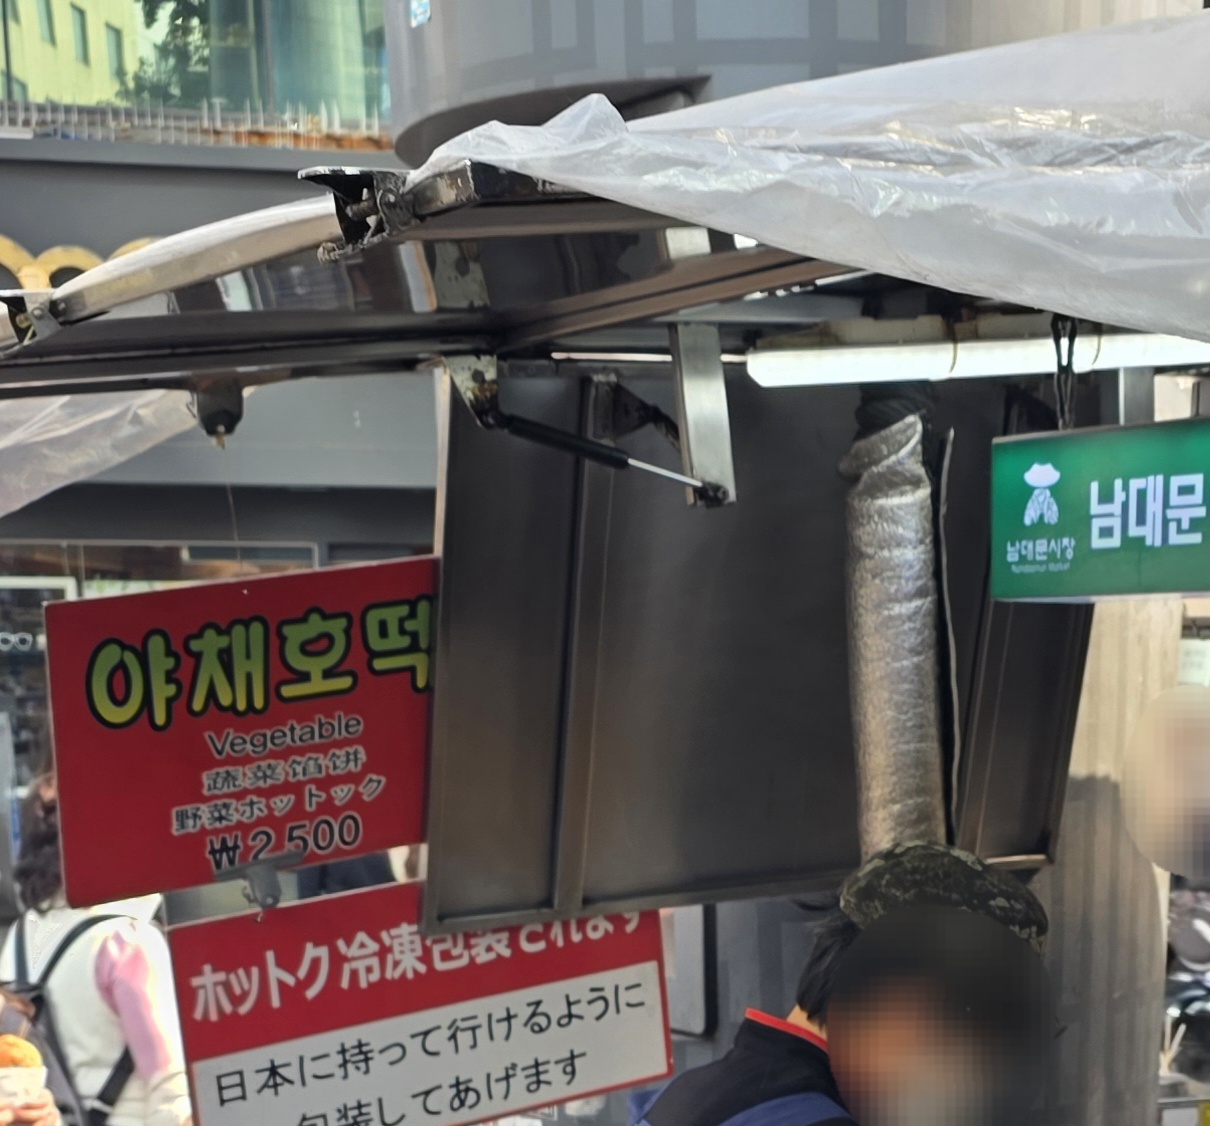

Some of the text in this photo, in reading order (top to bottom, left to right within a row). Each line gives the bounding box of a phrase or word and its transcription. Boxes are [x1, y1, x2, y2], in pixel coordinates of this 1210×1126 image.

[1090, 473, 1206, 550] 남대문
[1006, 537, 1076, 563] 남대문시장
[87, 597, 436, 730] 야채호떡
[205, 713, 363, 758] Vegetable
[202, 748, 366, 795] 蔬菜馅饼
[171, 775, 387, 835] 野菜ホットック
[216, 981, 647, 1108] 日本に持って行けるように
